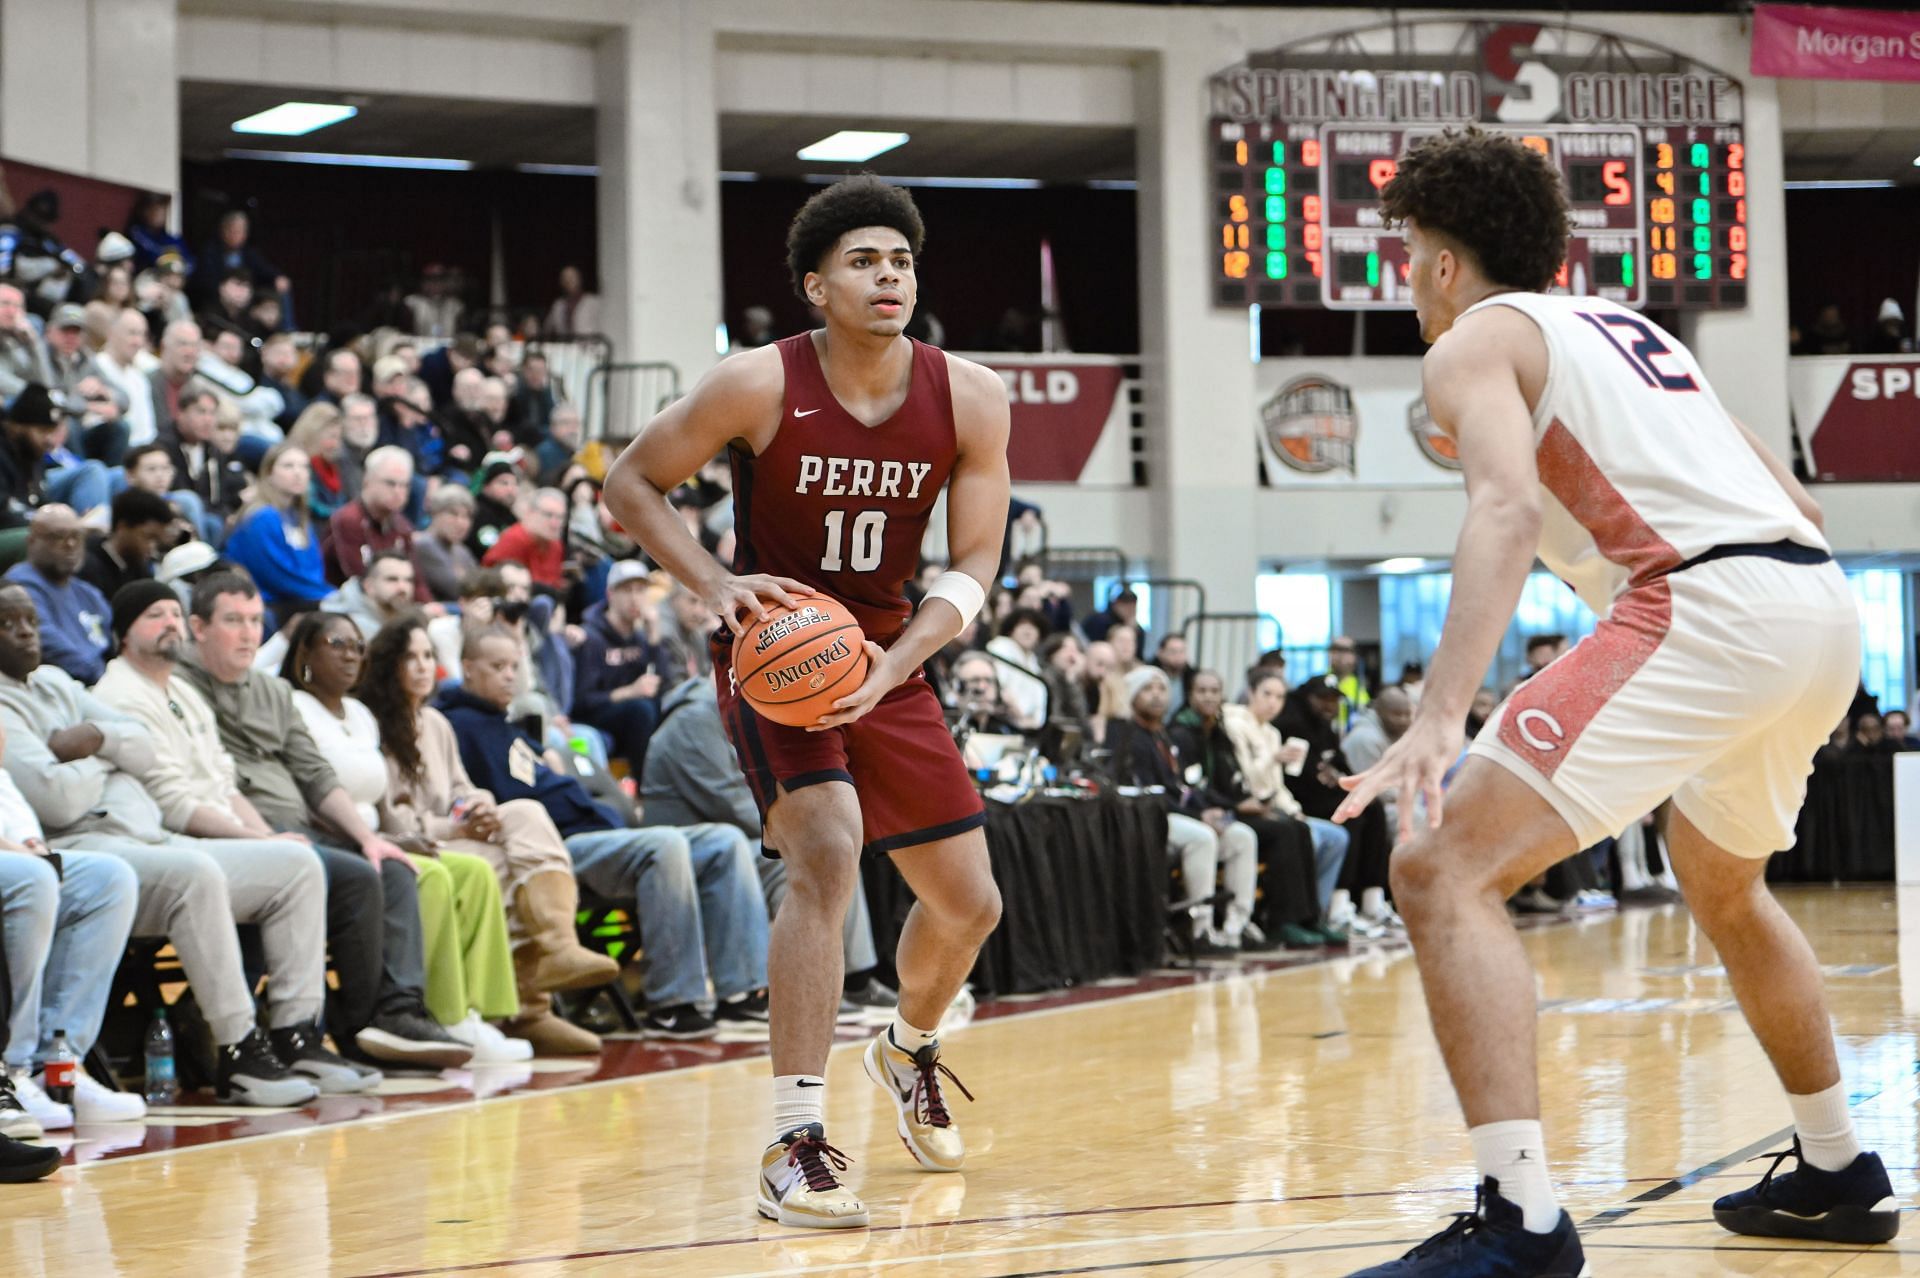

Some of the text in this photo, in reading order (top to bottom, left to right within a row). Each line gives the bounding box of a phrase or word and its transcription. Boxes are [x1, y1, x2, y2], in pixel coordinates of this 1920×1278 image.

[1796, 26, 1904, 64] Morgan
[1229, 67, 1732, 122] SPRINGFIELD COLLEGE
[1560, 132, 1635, 157] VISITOR
[1727, 143, 1745, 169] 2
[1602, 161, 1631, 206] 5
[1727, 171, 1745, 197] 0
[1650, 225, 1676, 251] 11
[1572, 311, 1700, 392] 12
[795, 454, 932, 499] PERRY
[819, 509, 889, 573] 10
[754, 612, 832, 656] PRECISION
[763, 635, 851, 693] SPALDING
[1515, 708, 1564, 752] C
